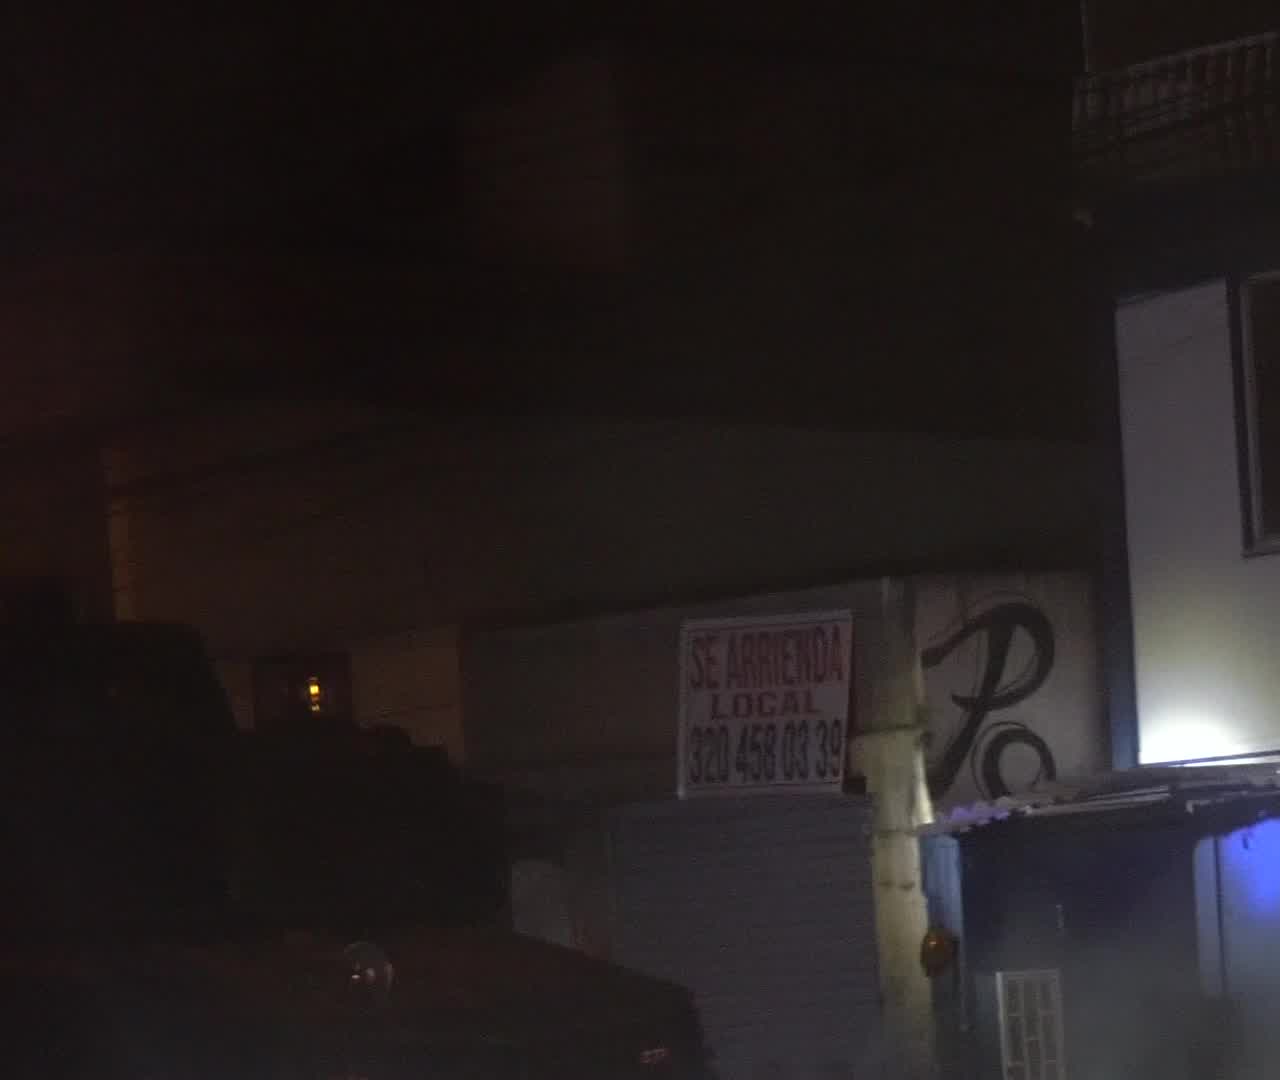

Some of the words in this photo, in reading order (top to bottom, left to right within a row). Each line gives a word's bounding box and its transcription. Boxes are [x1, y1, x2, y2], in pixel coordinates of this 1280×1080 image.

[690, 631, 720, 689] SE
[727, 623, 843, 689] ARRIENDA
[711, 689, 822, 720] LOCAL
[690, 725, 730, 785] 320
